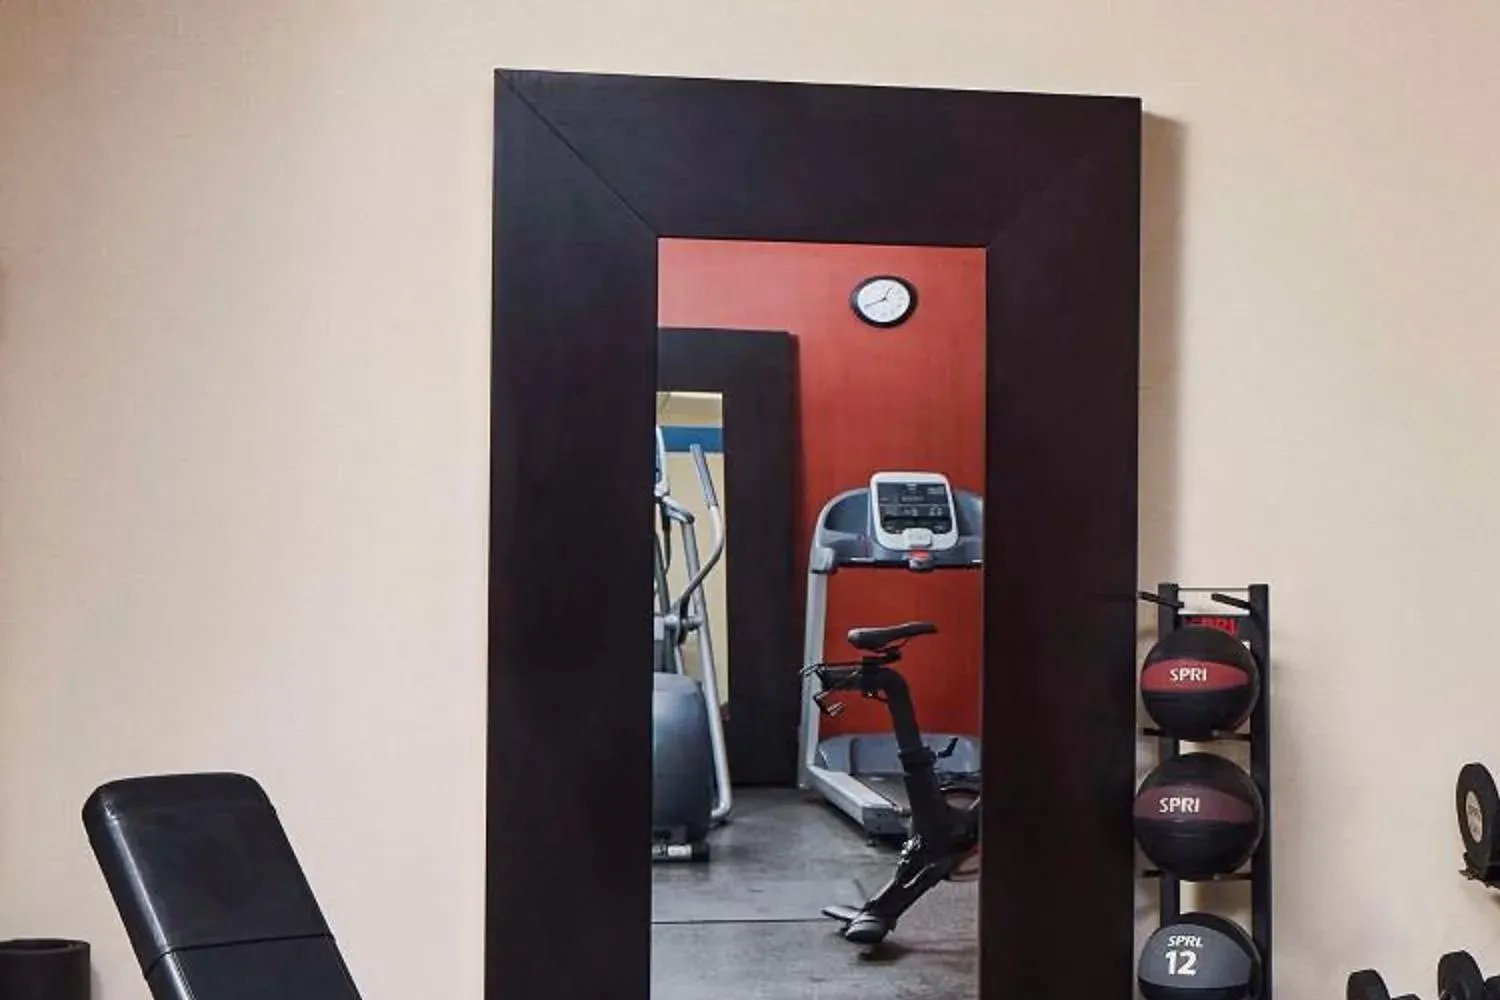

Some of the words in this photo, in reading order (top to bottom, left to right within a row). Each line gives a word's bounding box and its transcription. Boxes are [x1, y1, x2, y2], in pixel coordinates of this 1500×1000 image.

[1169, 667, 1207, 681] SPRI
[1159, 797, 1200, 813] SPRI
[1165, 950, 1197, 975] 12
